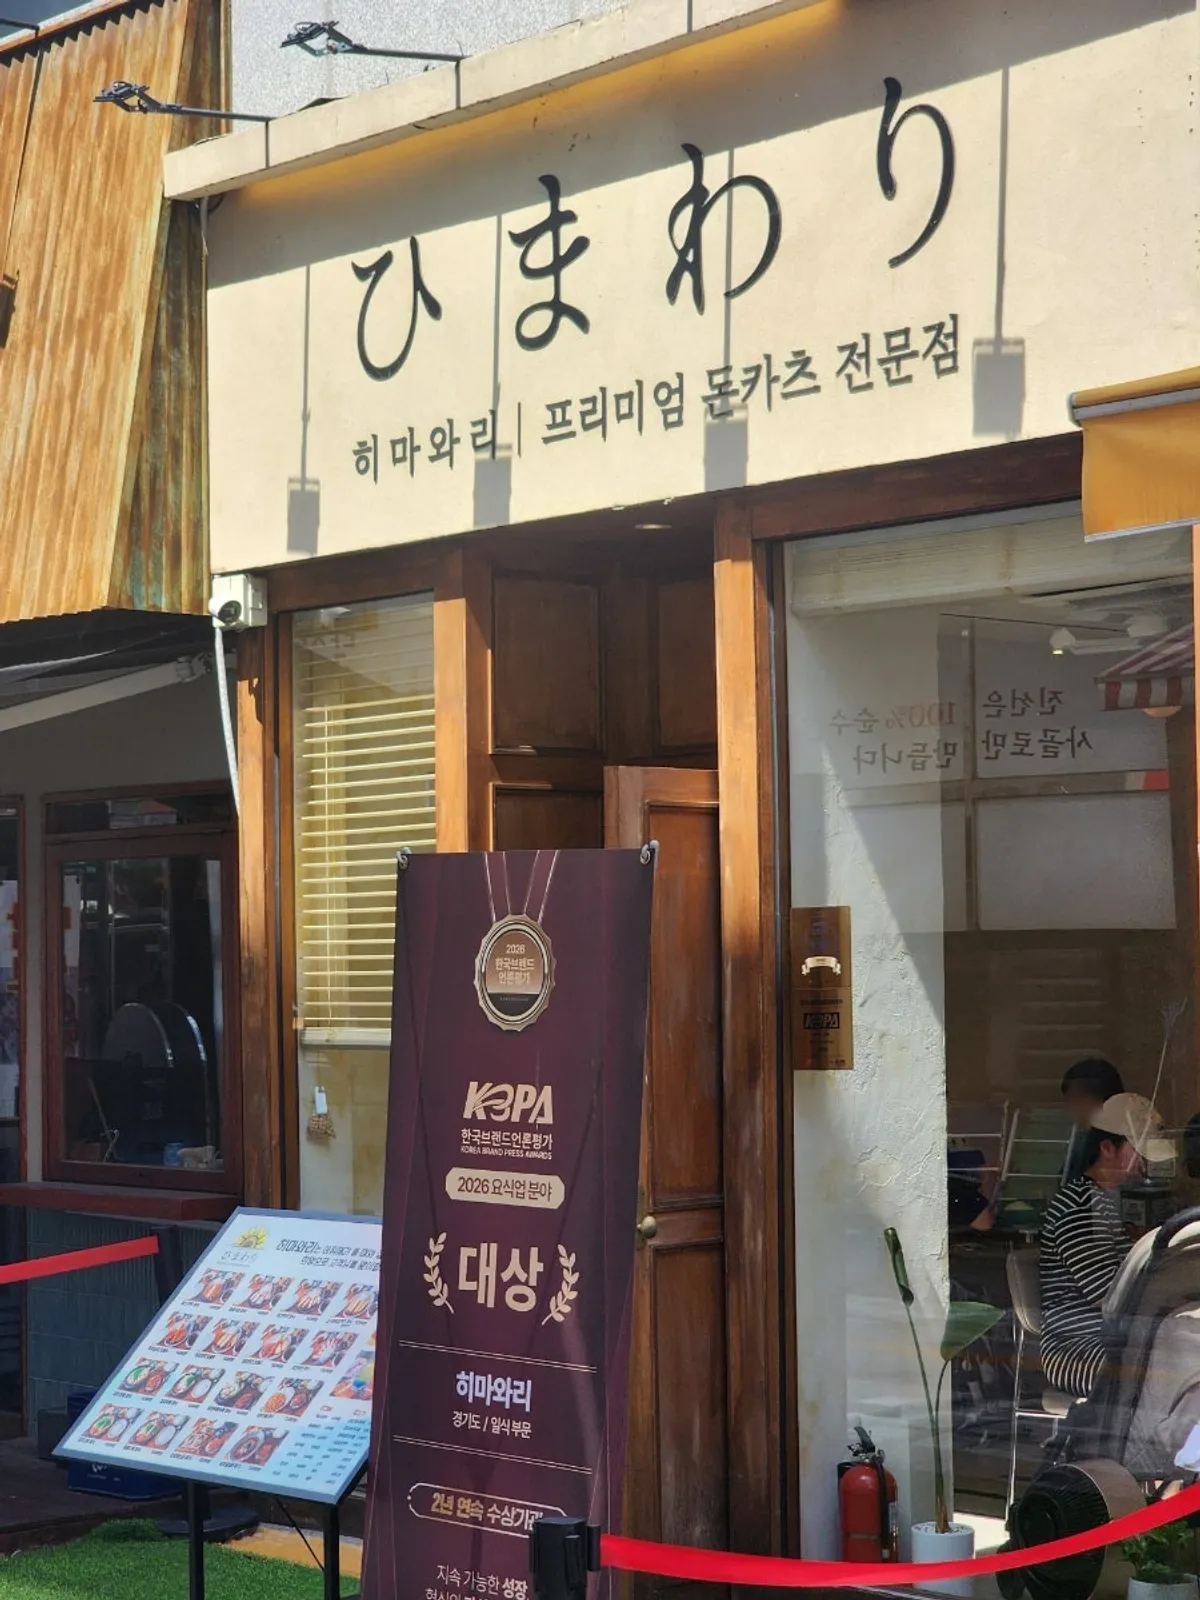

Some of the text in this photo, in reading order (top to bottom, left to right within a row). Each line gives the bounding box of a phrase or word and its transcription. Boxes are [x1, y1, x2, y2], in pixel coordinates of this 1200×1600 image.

[351, 76, 956, 381] ひまわり
[352, 313, 959, 484] 히마와리 프리미엄 돈카츠 전문점
[506, 944, 526, 954] 2026
[463, 1081, 554, 1125] KOPA
[461, 1128, 553, 1151] 한국브랜드언론평가
[461, 1145, 552, 1160] KOREA BRAND PRESS AWARDS
[457, 1176, 489, 1194] 2026
[528, 1181, 553, 1202] 분야
[459, 1243, 544, 1312] 대상
[456, 1371, 532, 1412] 히마와리
[452, 1410, 481, 1429] 경기도
[430, 1492, 455, 1516] 2년
[456, 1496, 484, 1522] 연속
[437, 1565, 462, 1588] 지속
[463, 1570, 500, 1596] 가능한
